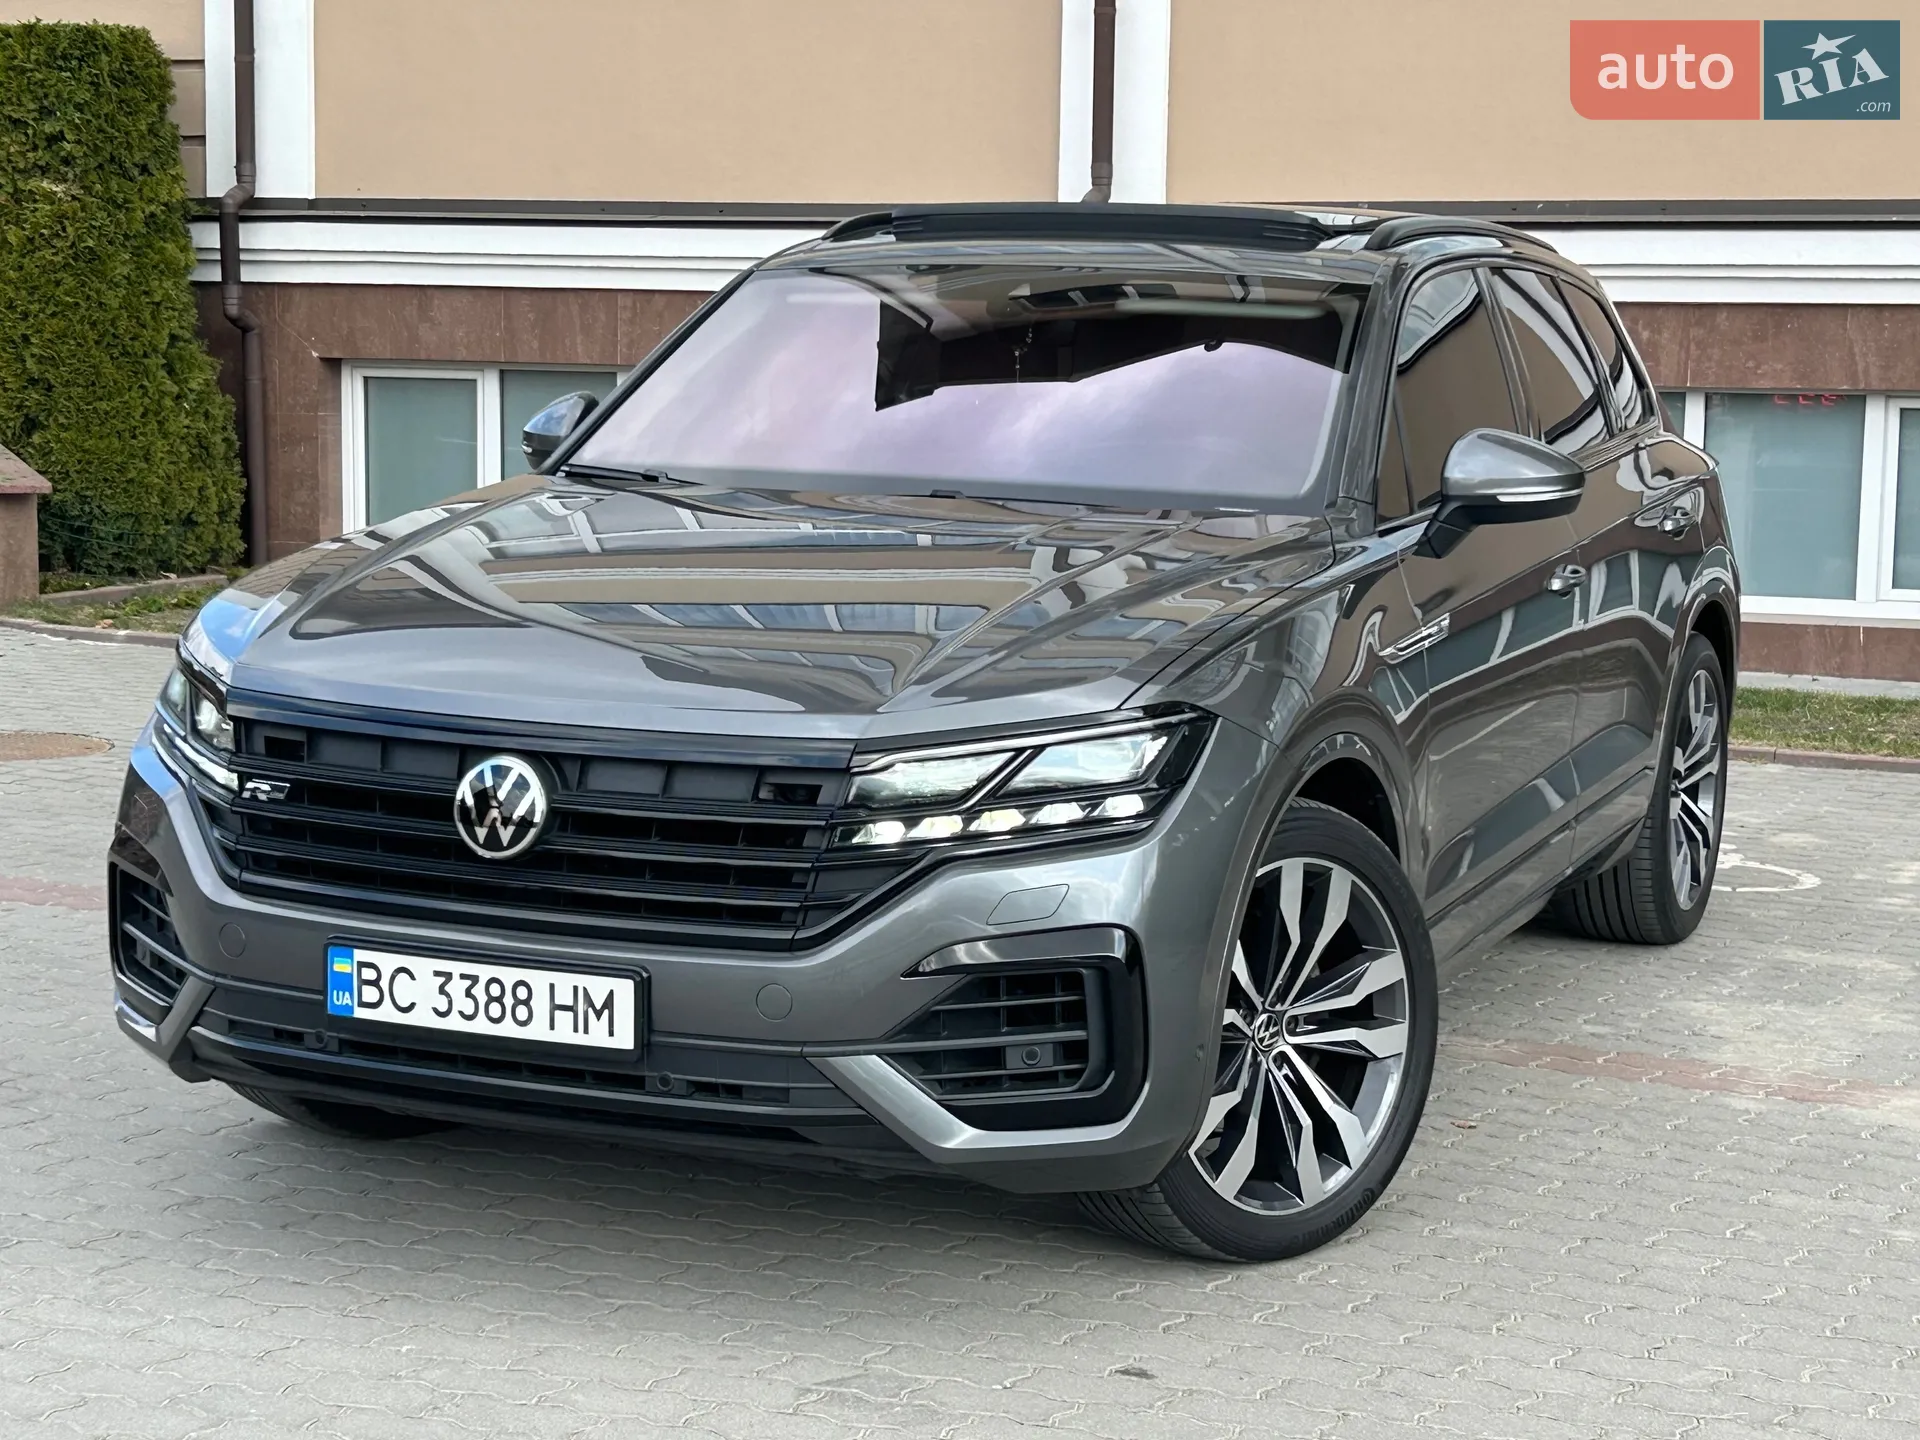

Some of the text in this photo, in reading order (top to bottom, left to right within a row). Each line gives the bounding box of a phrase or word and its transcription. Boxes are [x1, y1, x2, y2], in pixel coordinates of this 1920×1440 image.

[333, 989, 353, 1006] UA
[357, 961, 615, 1038] BC 3388 HM
